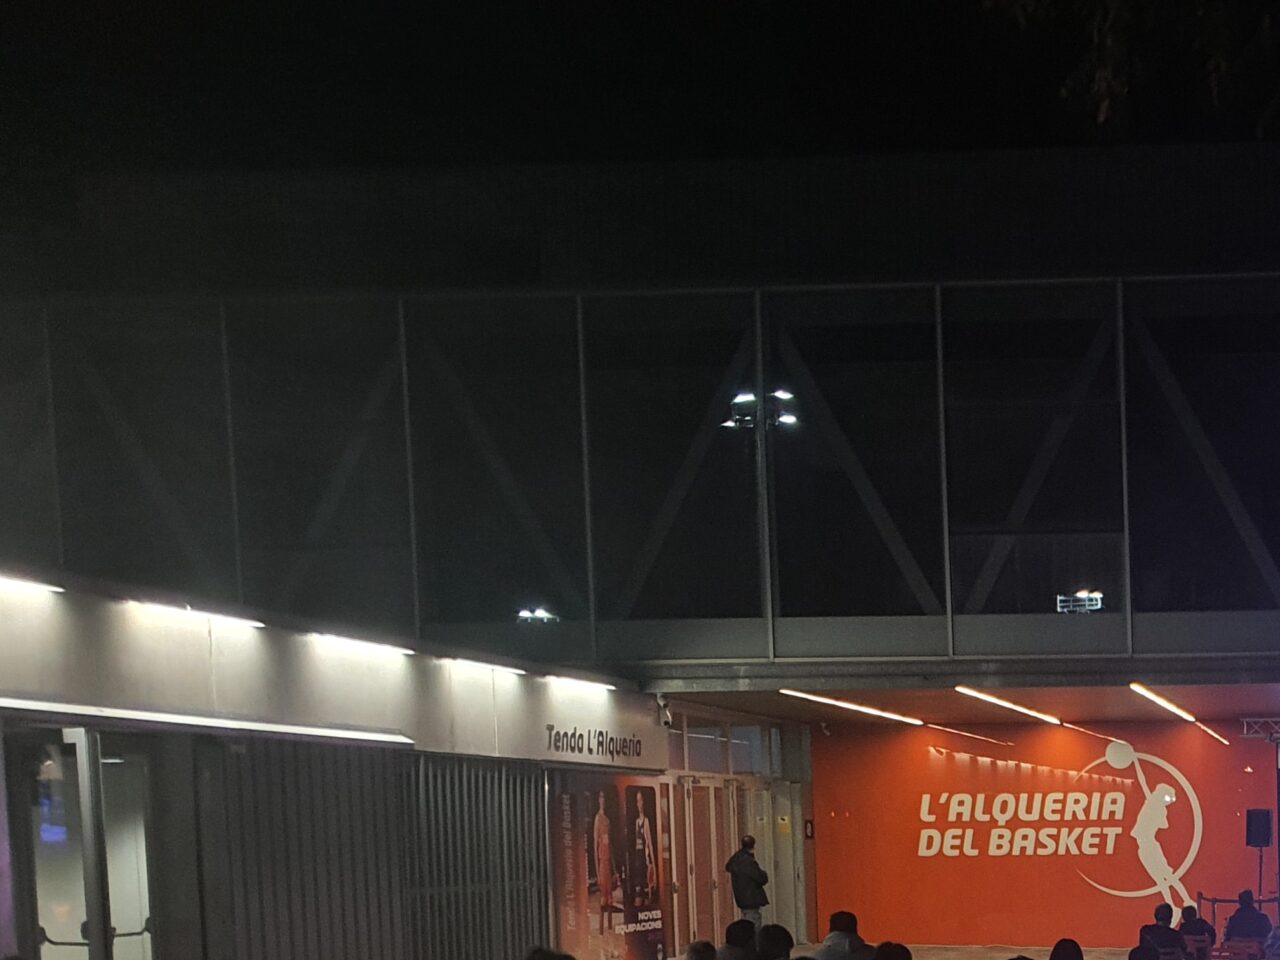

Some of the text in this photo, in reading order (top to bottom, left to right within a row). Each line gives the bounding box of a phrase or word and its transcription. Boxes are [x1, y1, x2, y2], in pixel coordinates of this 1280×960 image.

[546, 723, 642, 762] Tenda L'Alqueria
[919, 792, 1126, 825] L'ALQUERIA
[918, 827, 1123, 857] DEL BASKET
[638, 910, 662, 920] NOVES
